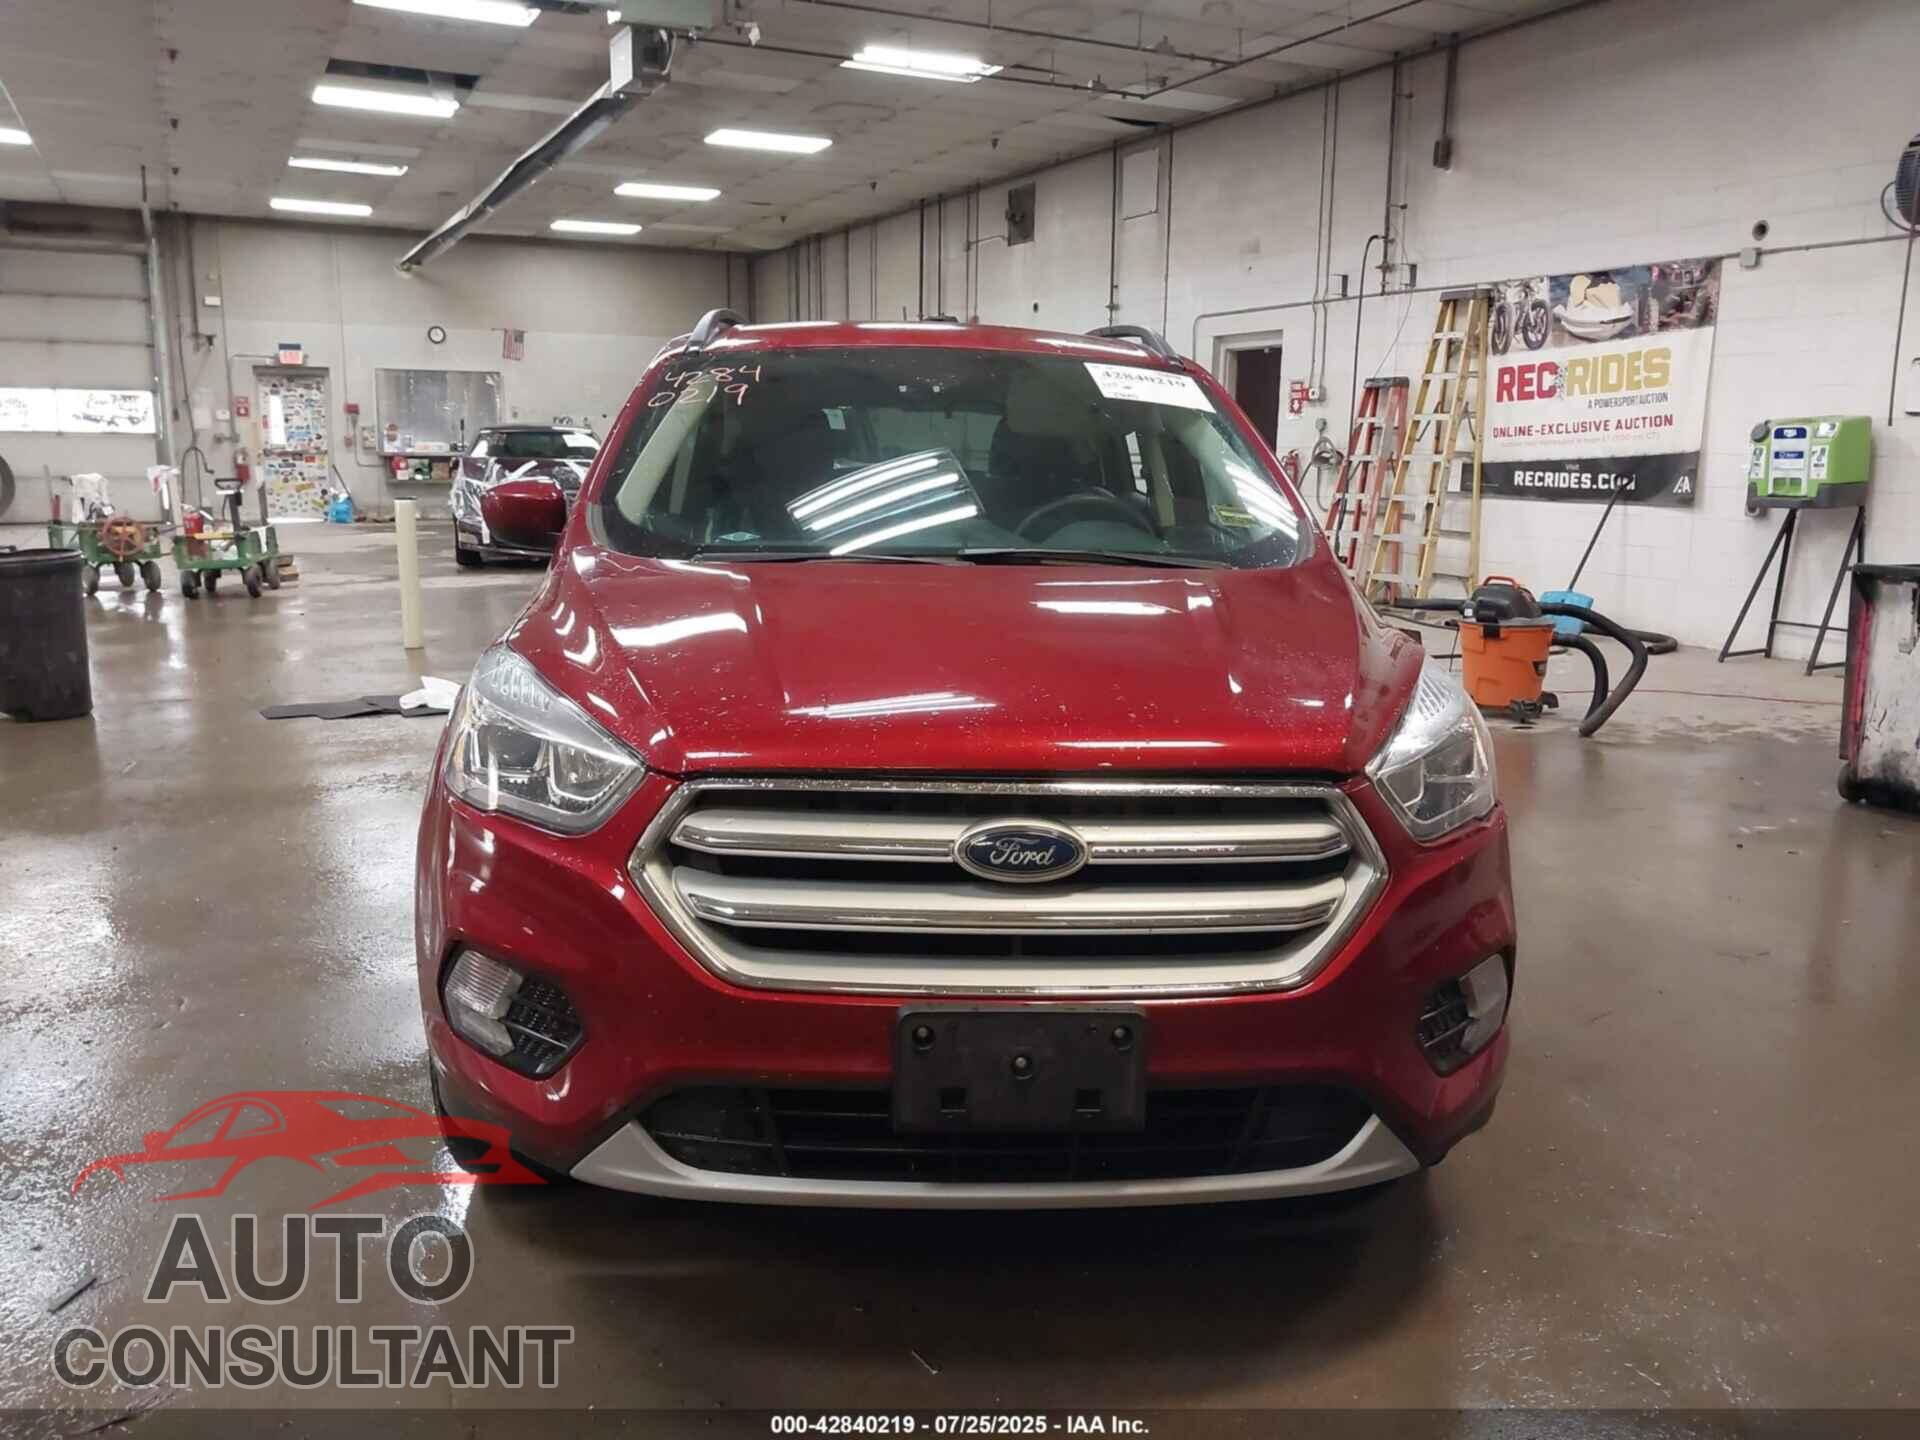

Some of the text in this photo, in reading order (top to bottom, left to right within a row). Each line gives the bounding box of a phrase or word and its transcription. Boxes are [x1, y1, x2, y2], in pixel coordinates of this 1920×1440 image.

[665, 364, 762, 388] 4284
[1496, 347, 1672, 403] REC RIDES
[647, 382, 750, 407] 0219
[1492, 413, 1674, 439] ONLINE-EXCLUSIVE AUCTION
[990, 837, 1057, 866] Ford
